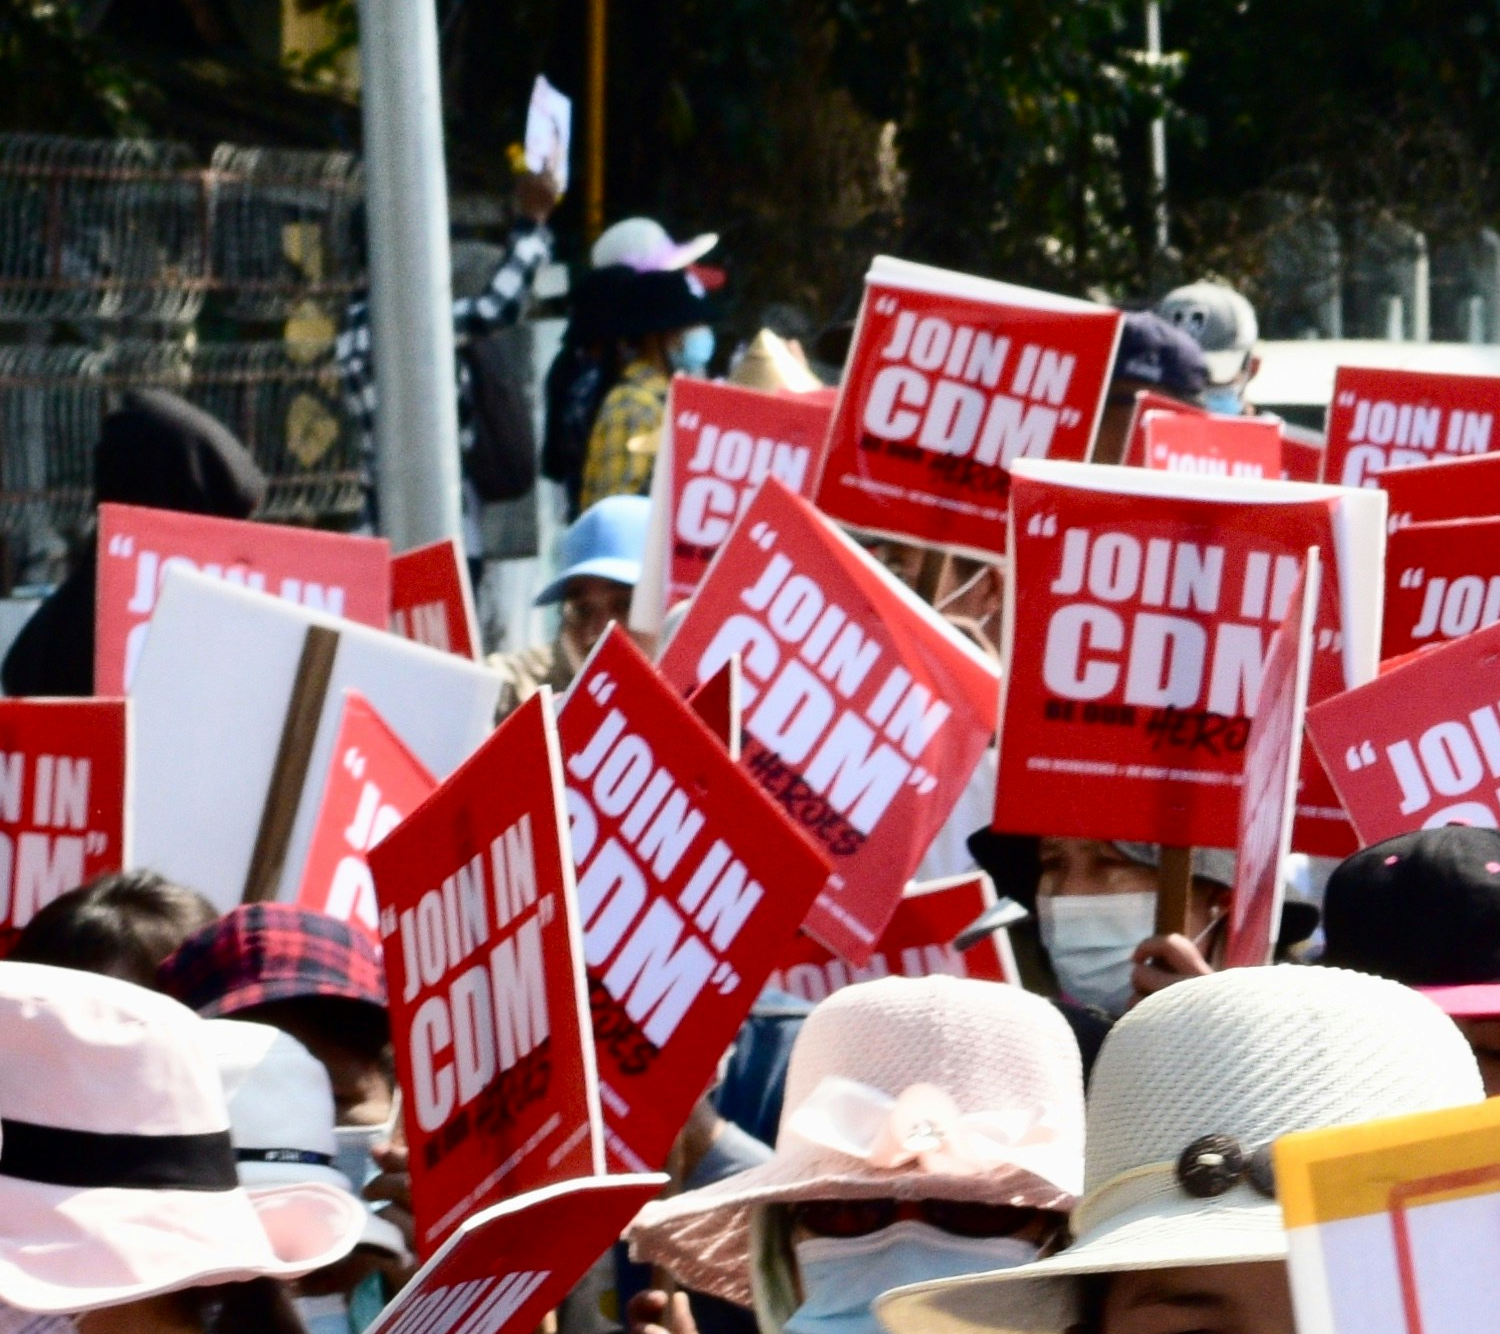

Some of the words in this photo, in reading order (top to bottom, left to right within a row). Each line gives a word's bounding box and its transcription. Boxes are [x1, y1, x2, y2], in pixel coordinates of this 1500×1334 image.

[1012, 343, 1077, 406] IN
[1444, 408, 1494, 456] IN
[1026, 513, 1225, 614] “JOIN
[1240, 551, 1322, 624] IN
[749, 521, 883, 698] “JOIN
[865, 663, 953, 760] IN
[1145, 703, 1252, 756] HERO
[32, 753, 92, 830] IN
[567, 671, 706, 882] “JOIN
[677, 838, 766, 954] IN
[489, 812, 538, 930] IN
[408, 892, 555, 1134] CDM”
